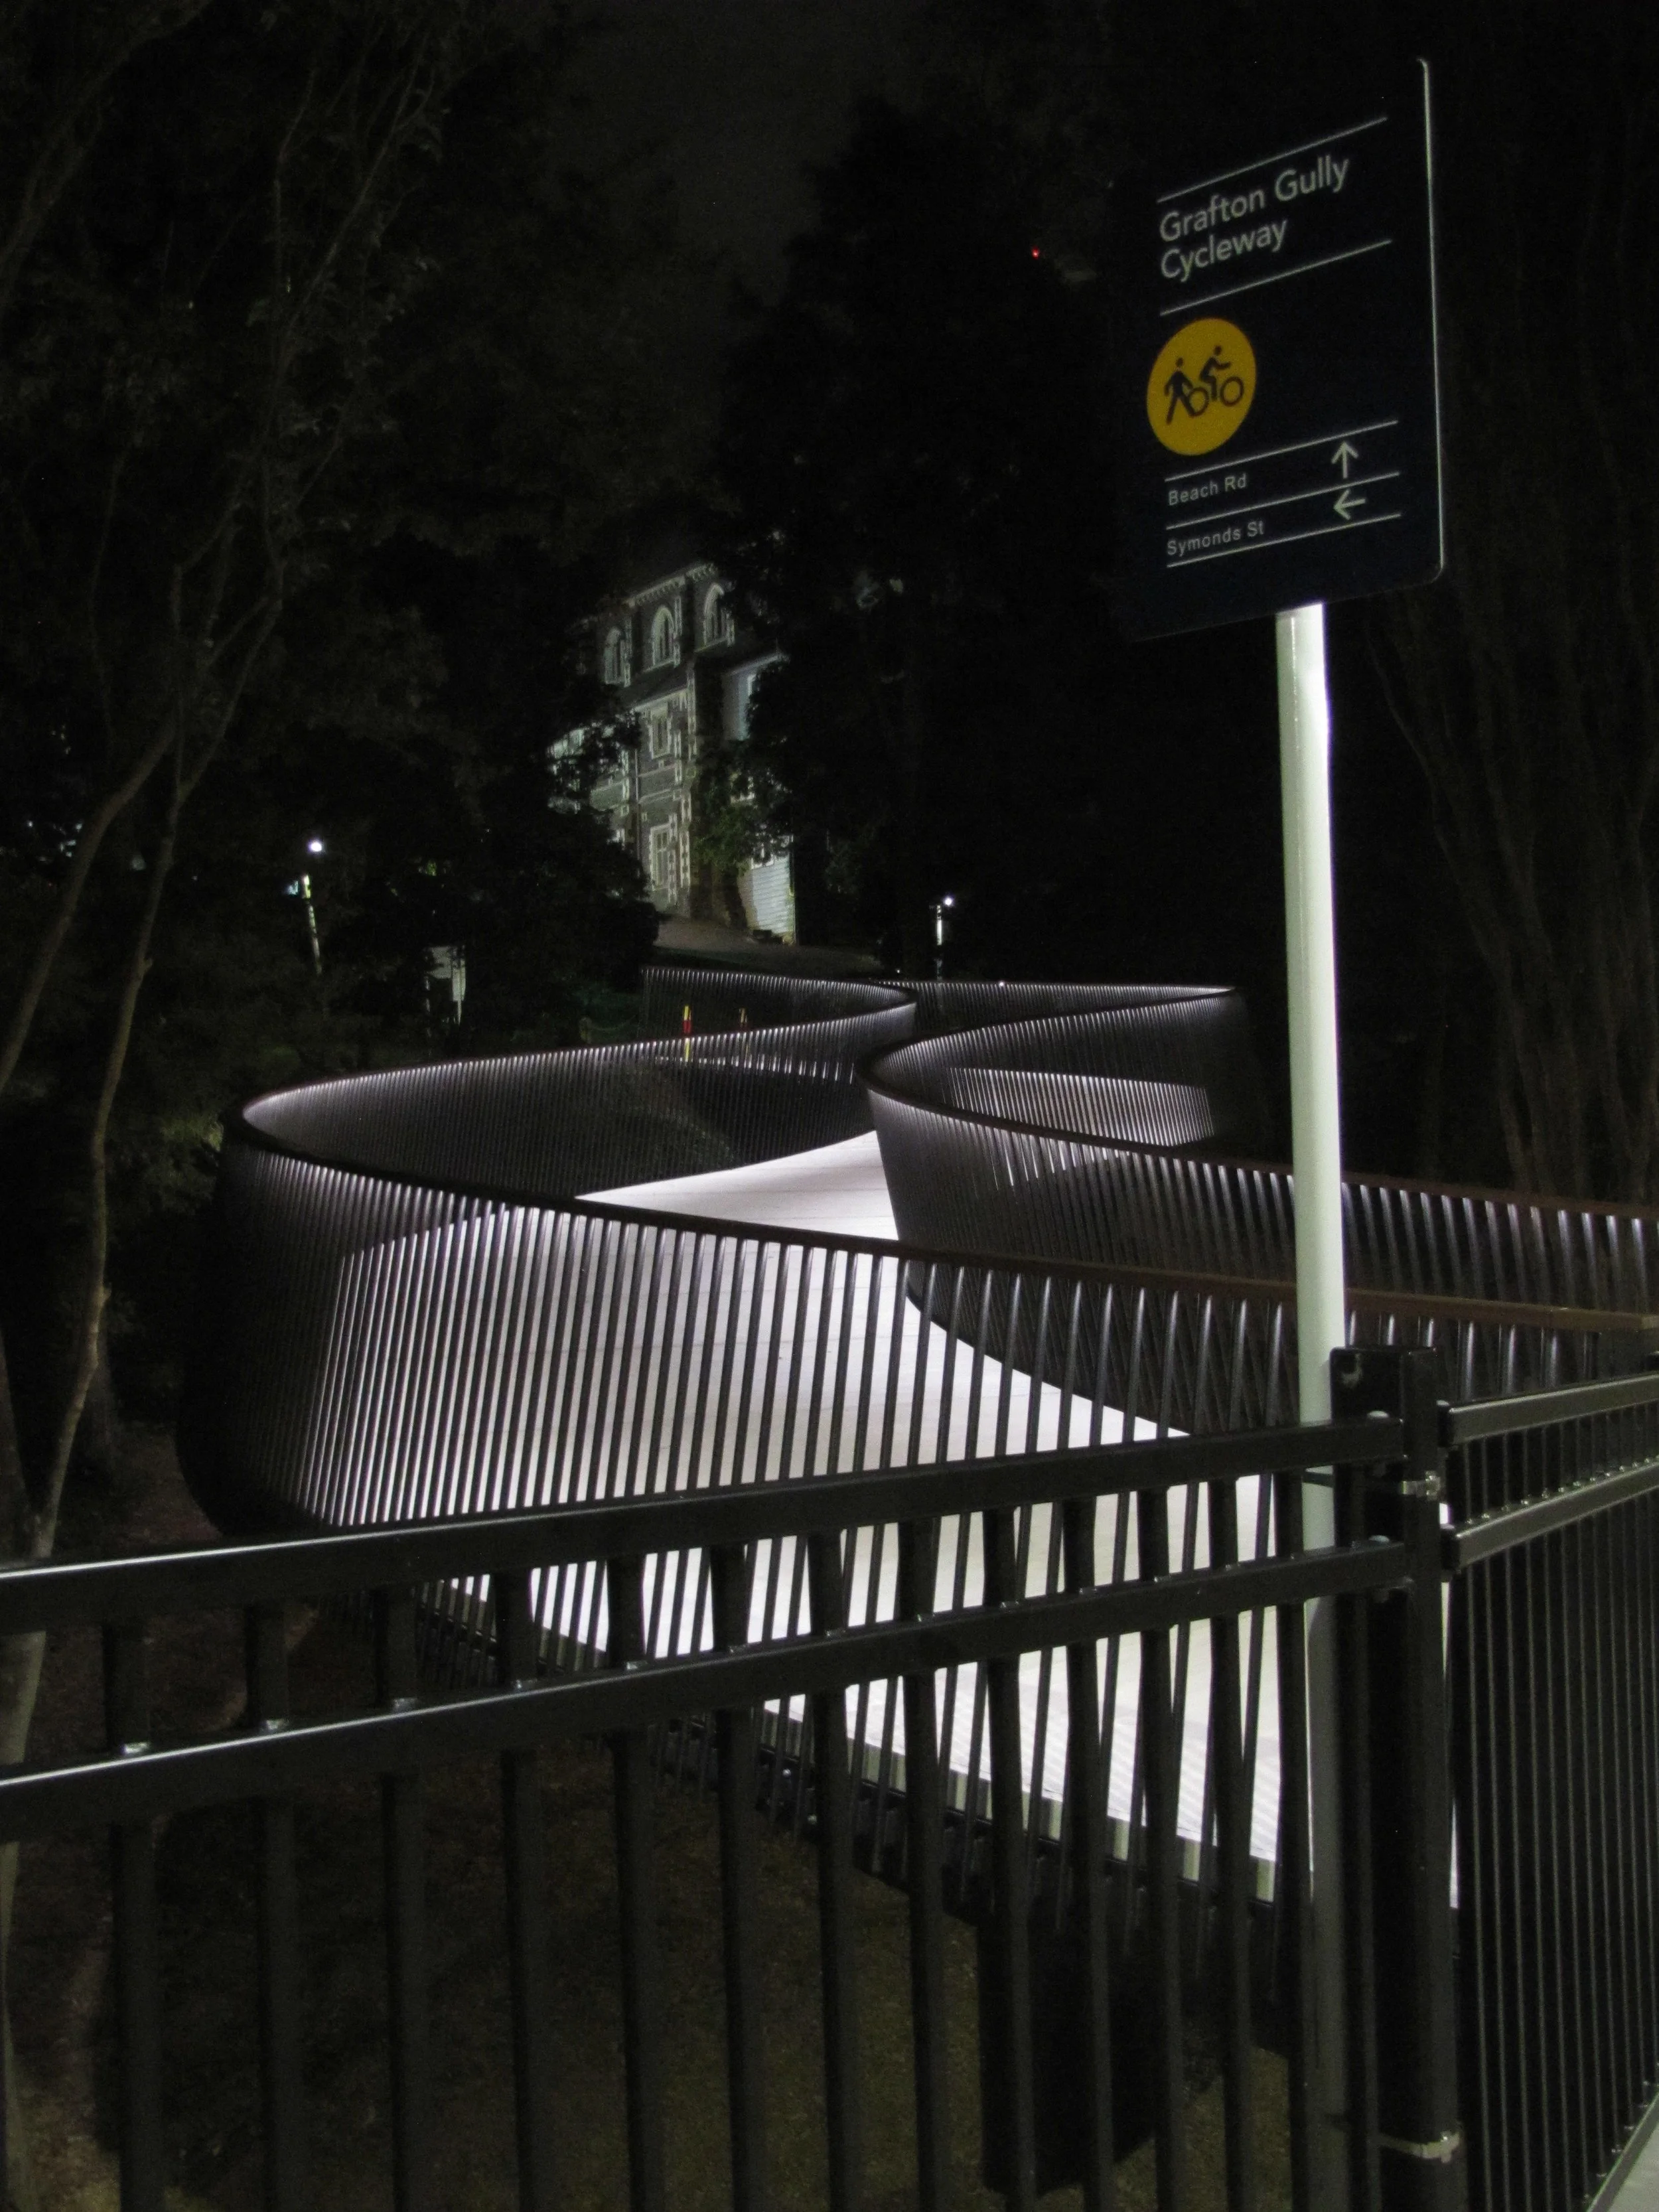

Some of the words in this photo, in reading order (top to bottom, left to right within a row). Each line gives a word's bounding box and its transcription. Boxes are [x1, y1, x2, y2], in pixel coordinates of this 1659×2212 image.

[1159, 188, 1265, 242] Grafton
[1274, 154, 1350, 202] Gully
[1161, 218, 1288, 283] Cycleway
[1168, 480, 1219, 506] Beach
[1224, 473, 1248, 492] Rd
[1166, 527, 1242, 557] Symonds
[1247, 520, 1264, 537] St
